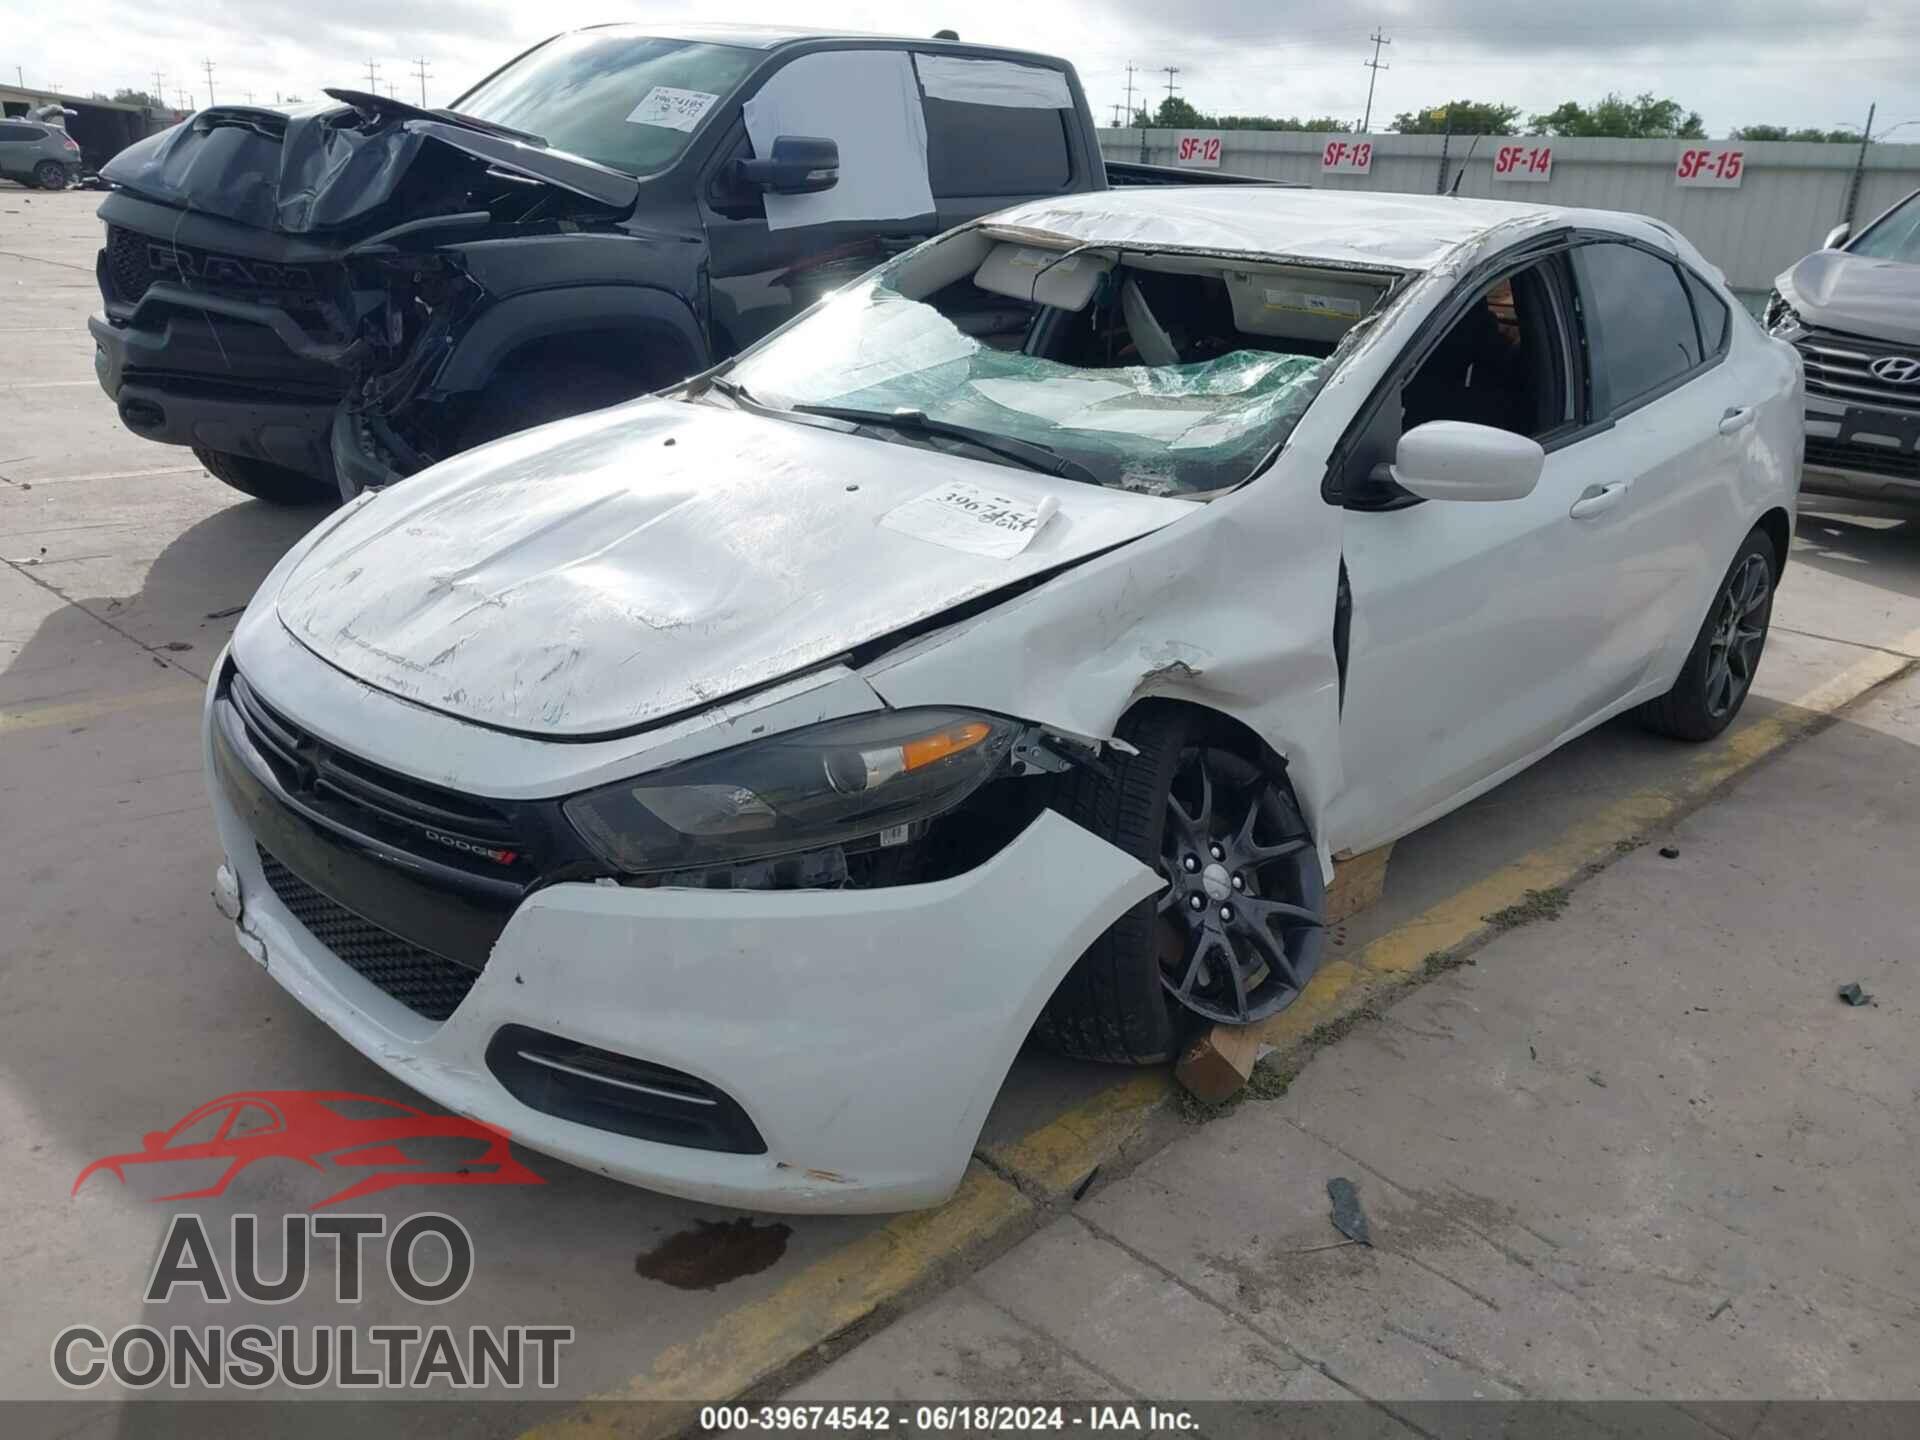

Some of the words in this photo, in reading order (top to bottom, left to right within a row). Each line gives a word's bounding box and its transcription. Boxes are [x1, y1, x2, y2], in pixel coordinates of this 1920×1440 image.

[1179, 138, 1221, 161] SF-12
[1324, 142, 1371, 167] SF-13
[1496, 147, 1551, 173] SF-14
[1678, 150, 1743, 179] SF-15
[147, 243, 314, 289] RAM
[425, 830, 504, 860] DODGE
